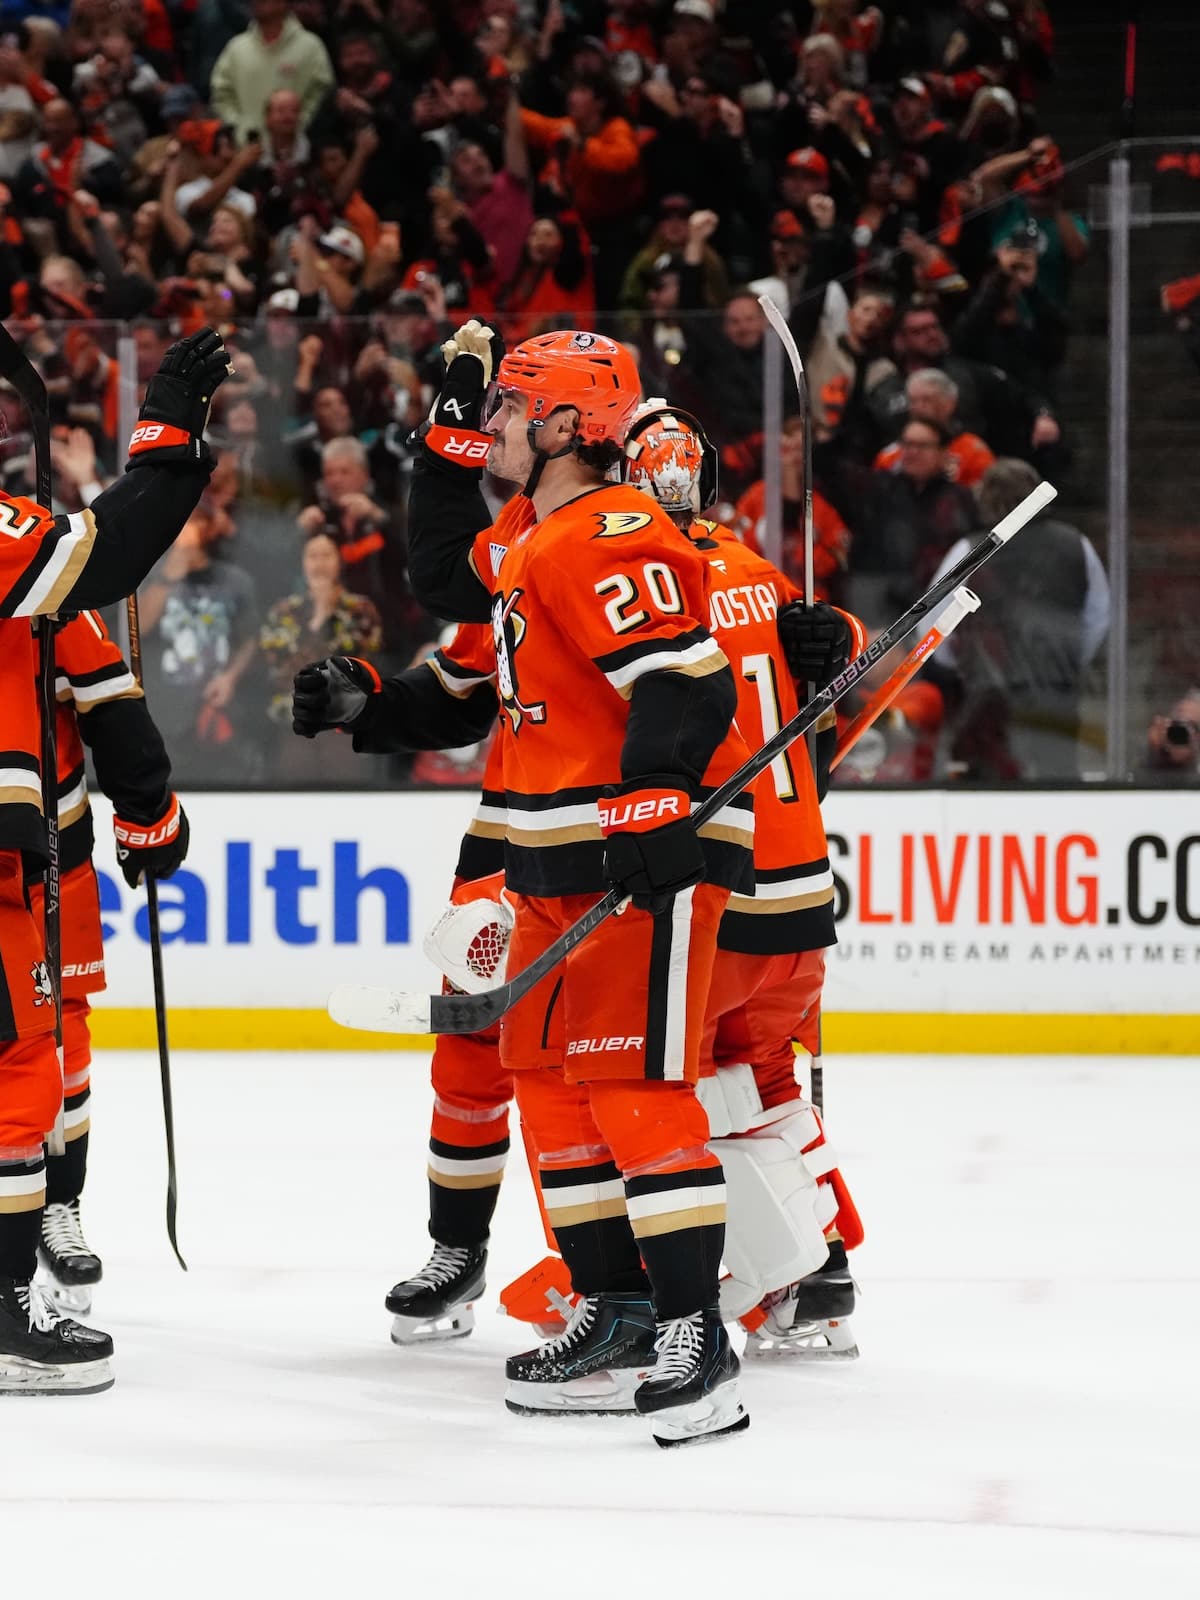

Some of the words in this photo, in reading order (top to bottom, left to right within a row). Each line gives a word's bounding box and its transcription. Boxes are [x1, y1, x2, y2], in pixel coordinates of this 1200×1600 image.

[594, 561, 686, 635] 20
[599, 796, 680, 828] AUER
[895, 940, 1009, 962] DREAM
[567, 1036, 644, 1056] BAUER
